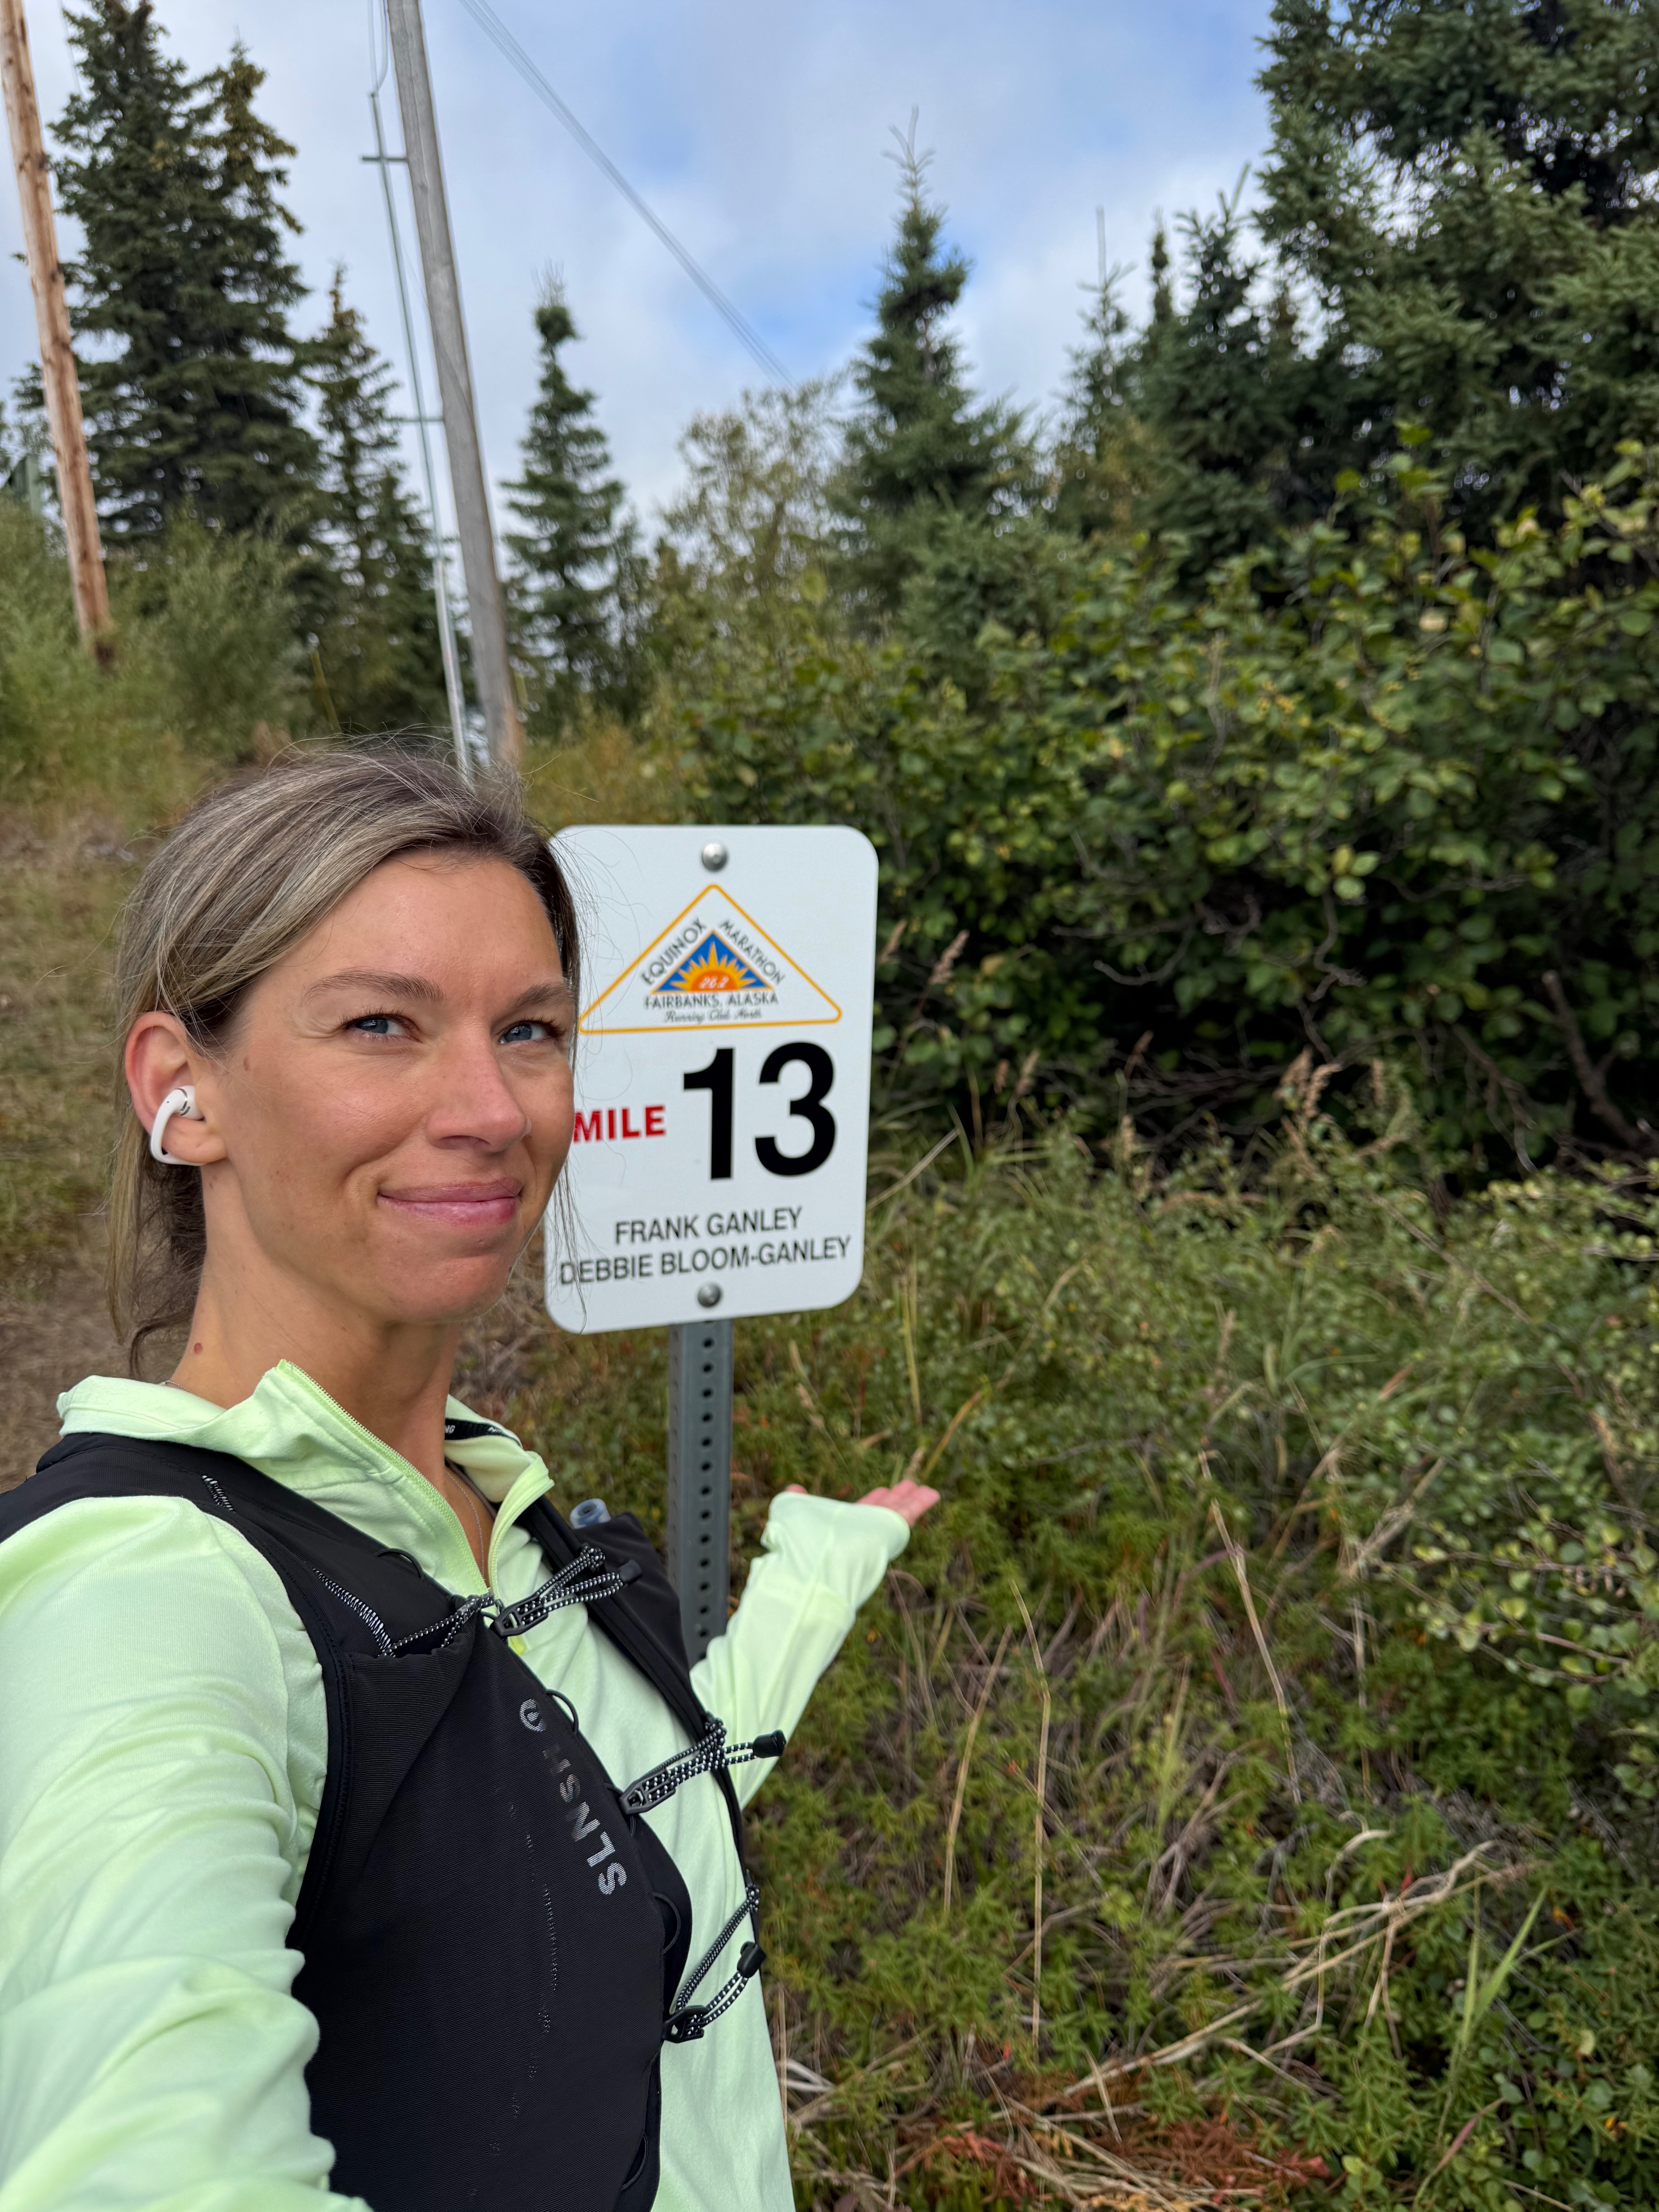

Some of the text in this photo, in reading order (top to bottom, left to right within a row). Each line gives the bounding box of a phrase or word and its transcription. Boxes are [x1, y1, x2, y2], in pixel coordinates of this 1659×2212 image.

[641, 917, 785, 985] EQUINOX MARATHON
[698, 974, 729, 989] 26.2
[728, 991, 779, 1005] ALASKA
[664, 1010, 705, 1024] Running
[573, 1041, 838, 1181] MILE 13
[615, 1206, 803, 1245] FRANK GANLEY
[560, 1235, 851, 1285] DEBBIE BLOOM-GANLEY
